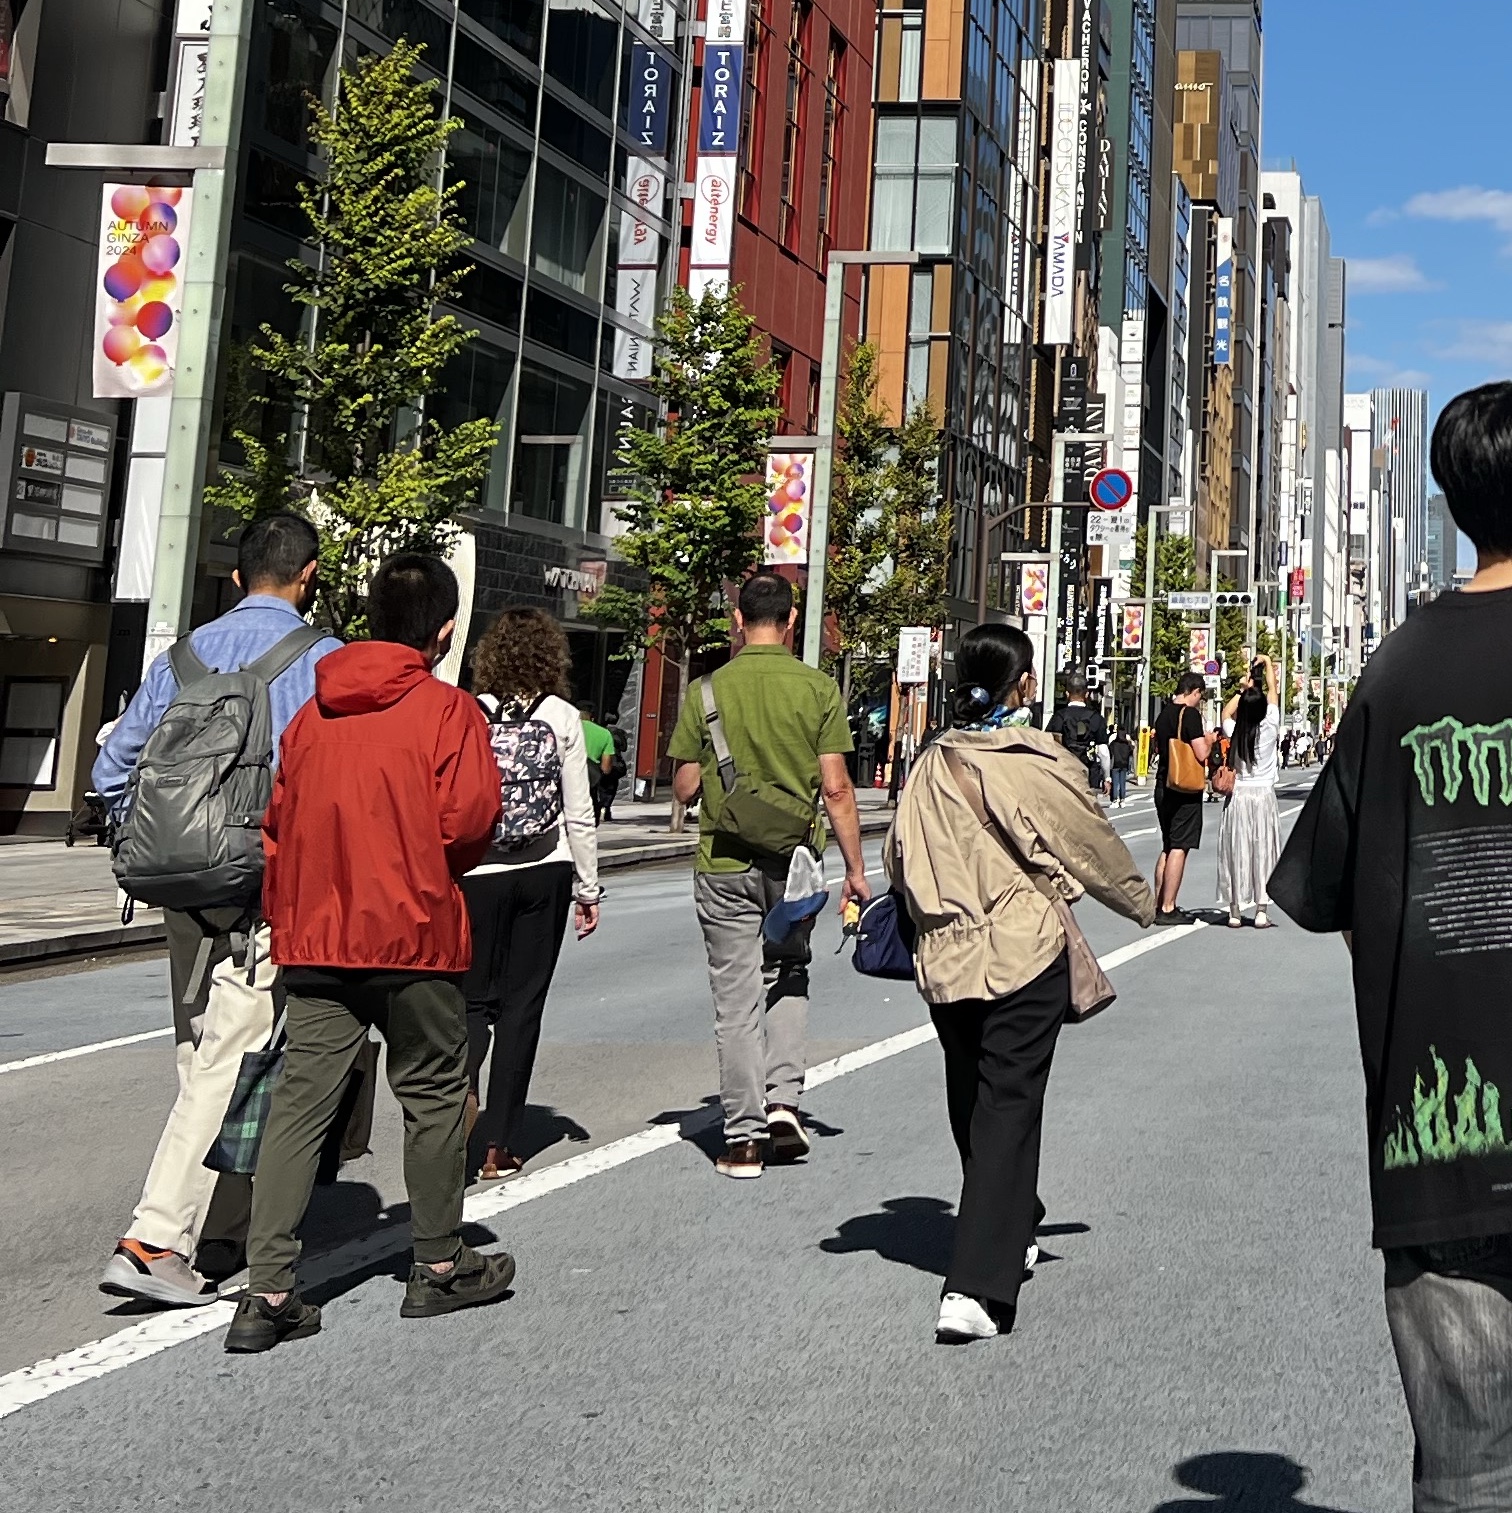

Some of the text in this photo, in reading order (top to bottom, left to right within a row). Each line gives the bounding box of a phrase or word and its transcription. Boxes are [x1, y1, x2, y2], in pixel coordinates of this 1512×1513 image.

[711, 51, 731, 147] TORAIZ
[704, 178, 724, 246] altenergy
[1075, 119, 1088, 244] CONSTANTIN
[1097, 139, 1111, 229] DAMIANI
[106, 246, 137, 256] 2024
[107, 220, 169, 231] AUTUMN
[107, 233, 150, 243] GINZA
[1051, 230, 1070, 298] YAMADA
